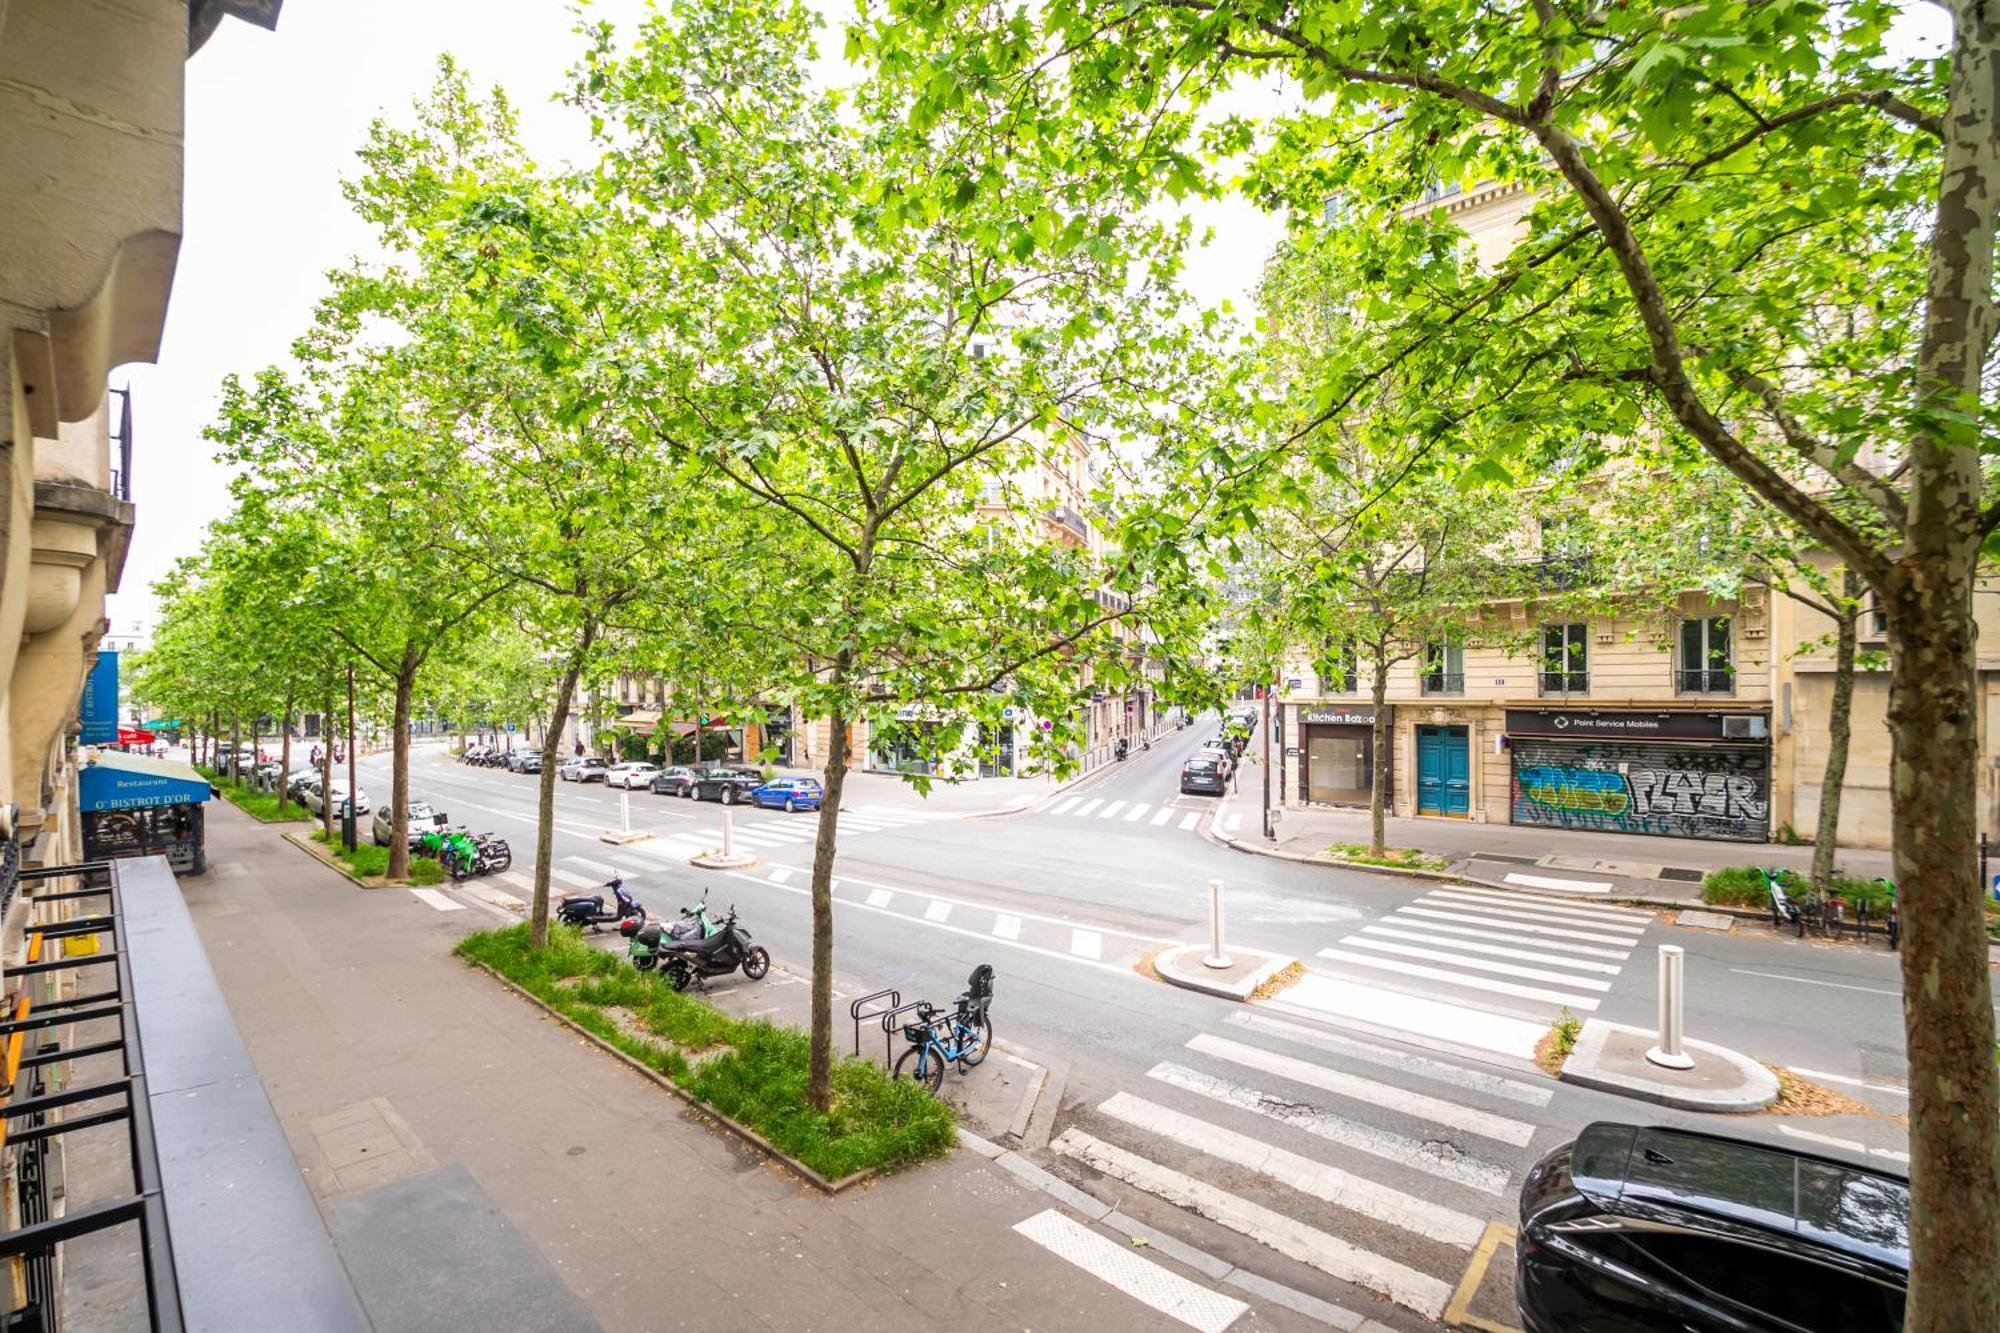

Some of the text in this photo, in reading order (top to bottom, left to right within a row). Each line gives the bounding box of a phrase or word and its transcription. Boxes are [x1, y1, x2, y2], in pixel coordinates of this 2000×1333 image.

[1307, 713, 1342, 722] Kitchen
[1595, 720, 1625, 728] Service
[1626, 720, 1659, 728] Mobiles
[117, 779, 168, 788] Restaurant
[111, 796, 161, 809] BISTROT
[163, 794, 191, 804] D'OR
